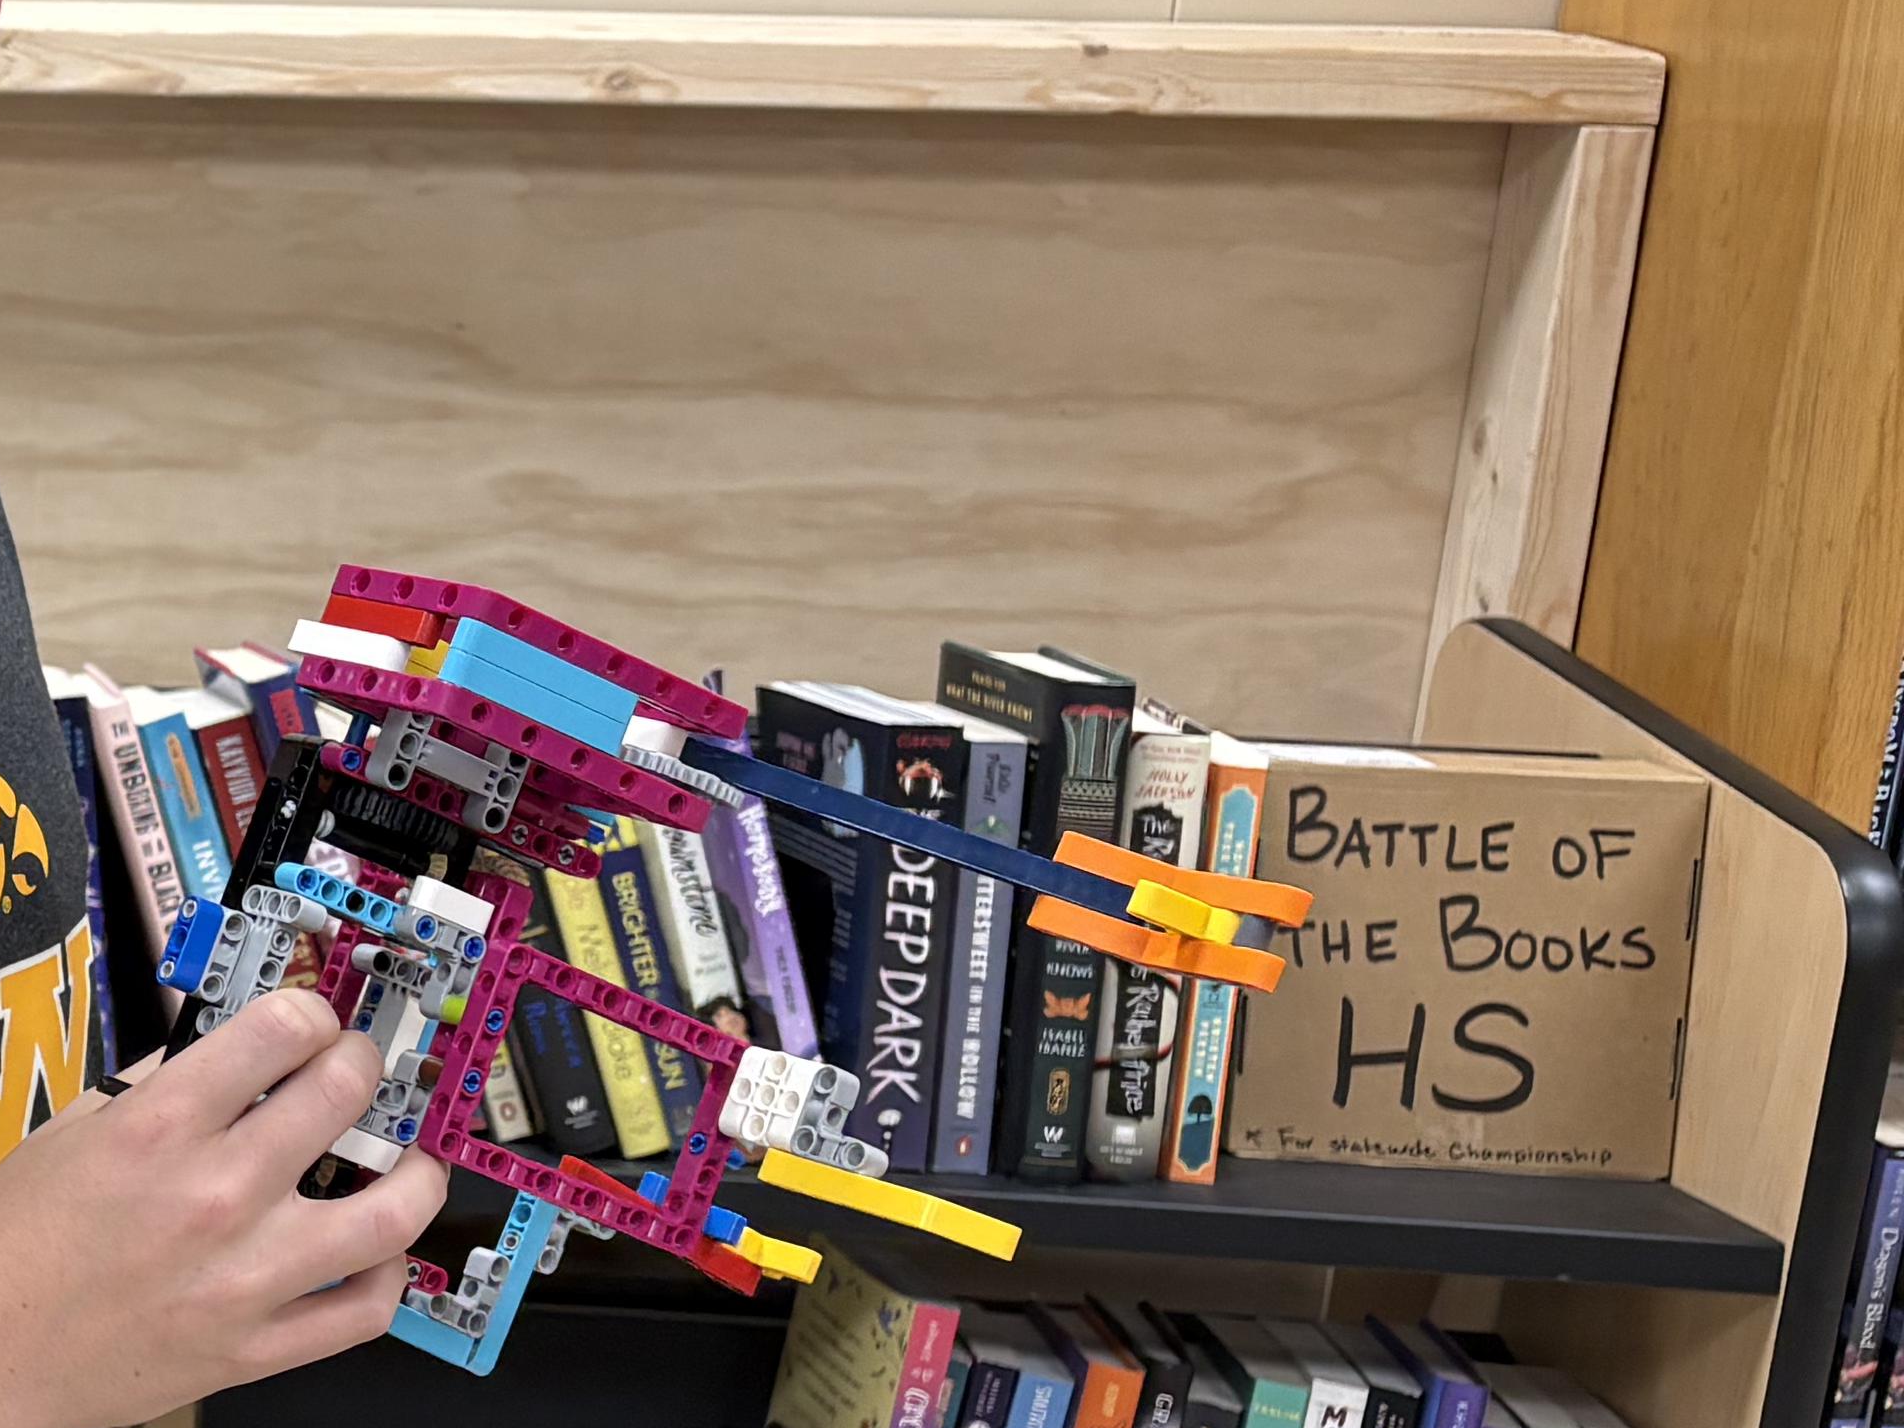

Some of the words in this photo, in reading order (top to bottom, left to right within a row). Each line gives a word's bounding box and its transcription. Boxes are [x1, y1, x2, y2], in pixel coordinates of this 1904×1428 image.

[1287, 785, 1515, 872] BATTLE
[1551, 829, 1636, 880] OF
[612, 871, 661, 988] BRIGHTER
[883, 843, 938, 965] DEEP
[1275, 919, 1398, 969] THE
[1440, 893, 1656, 972] BOOKS
[865, 964, 927, 1106] DARK
[1332, 996, 1535, 1113] HS
